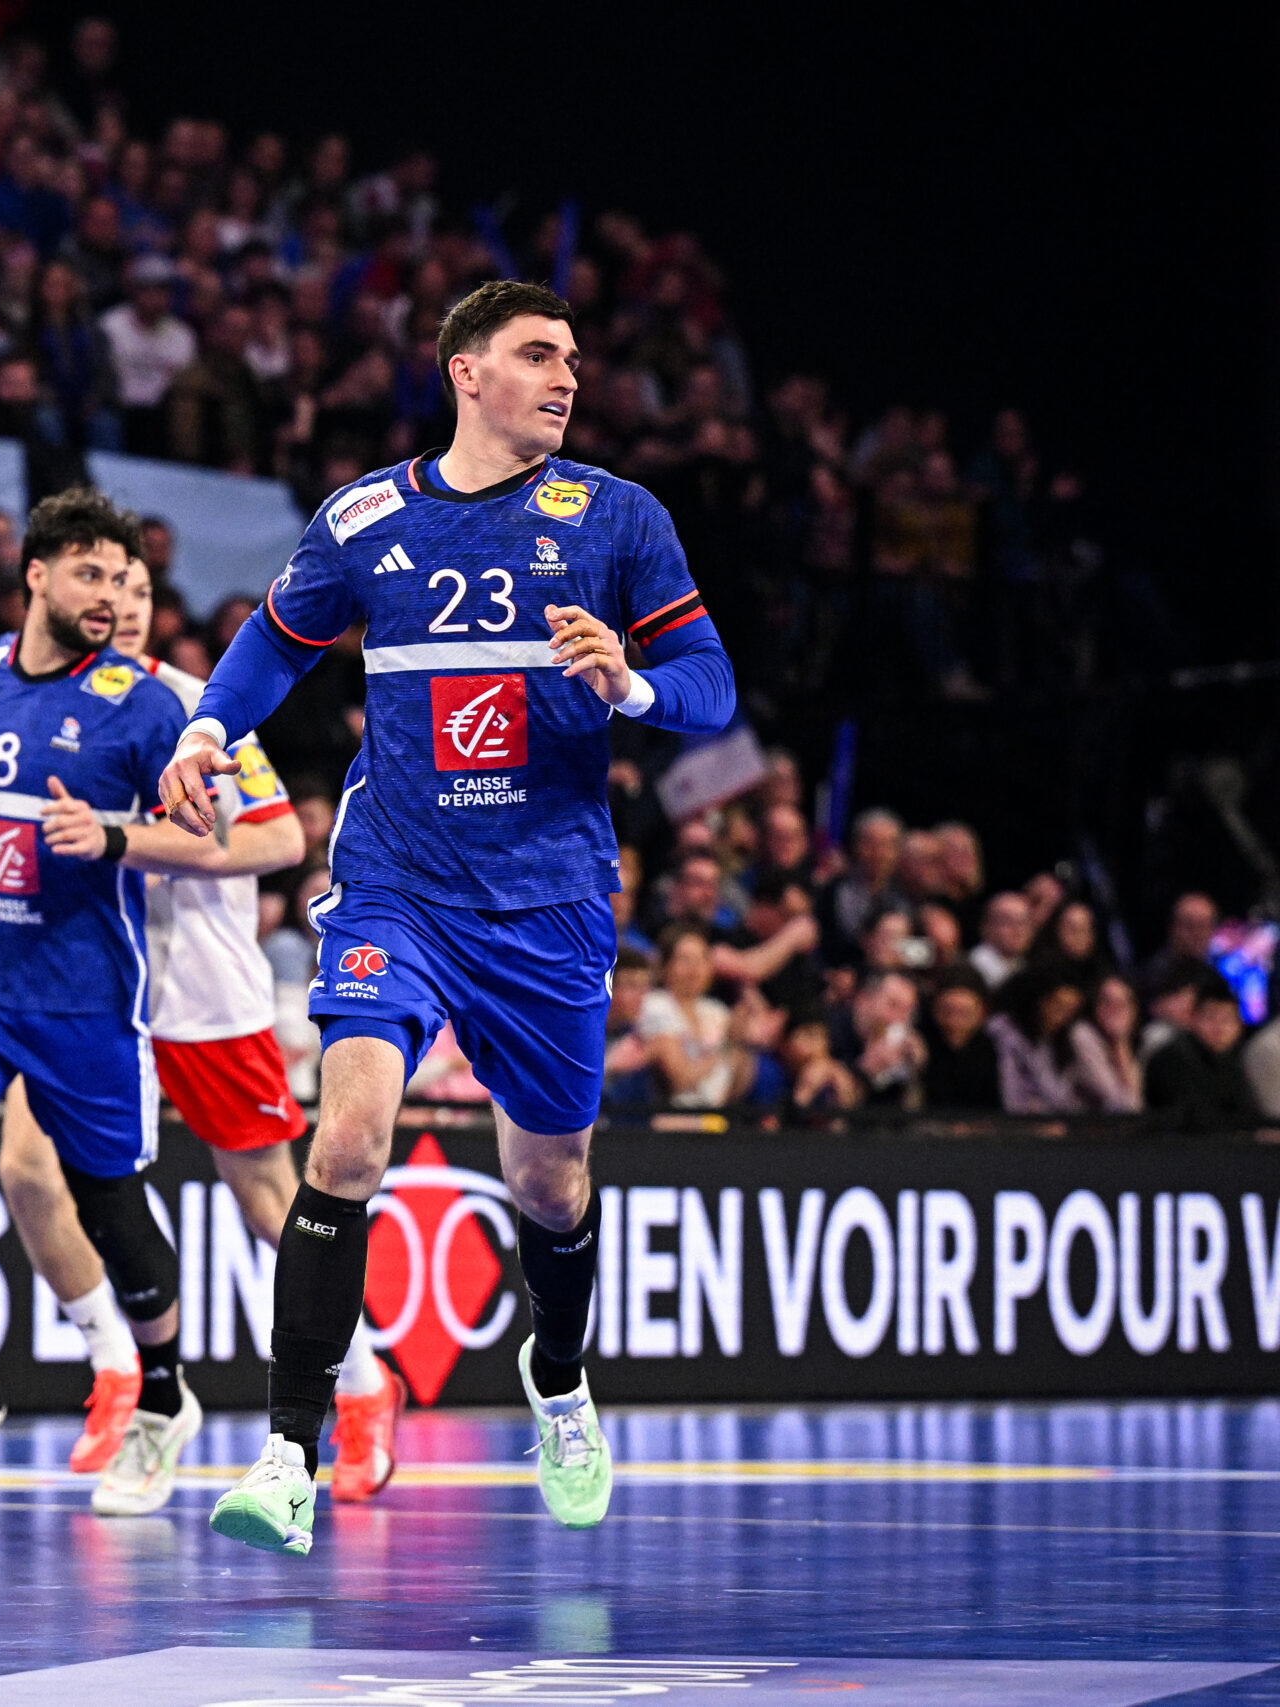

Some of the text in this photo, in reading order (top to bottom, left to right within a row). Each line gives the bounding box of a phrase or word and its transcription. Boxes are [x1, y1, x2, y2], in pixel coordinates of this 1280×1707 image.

[339, 489, 393, 523] Butagaz
[428, 568, 517, 633] 23
[453, 776, 512, 792] CAISSE
[438, 789, 527, 807] D'EPARGNE
[335, 981, 380, 995] OPTICAL
[295, 1215, 338, 1237] SELECT
[552, 1230, 593, 1253] SELECT
[582, 1184, 744, 1358] IEN
[757, 1186, 980, 1358] VOIR
[993, 1189, 1232, 1356] POUR
